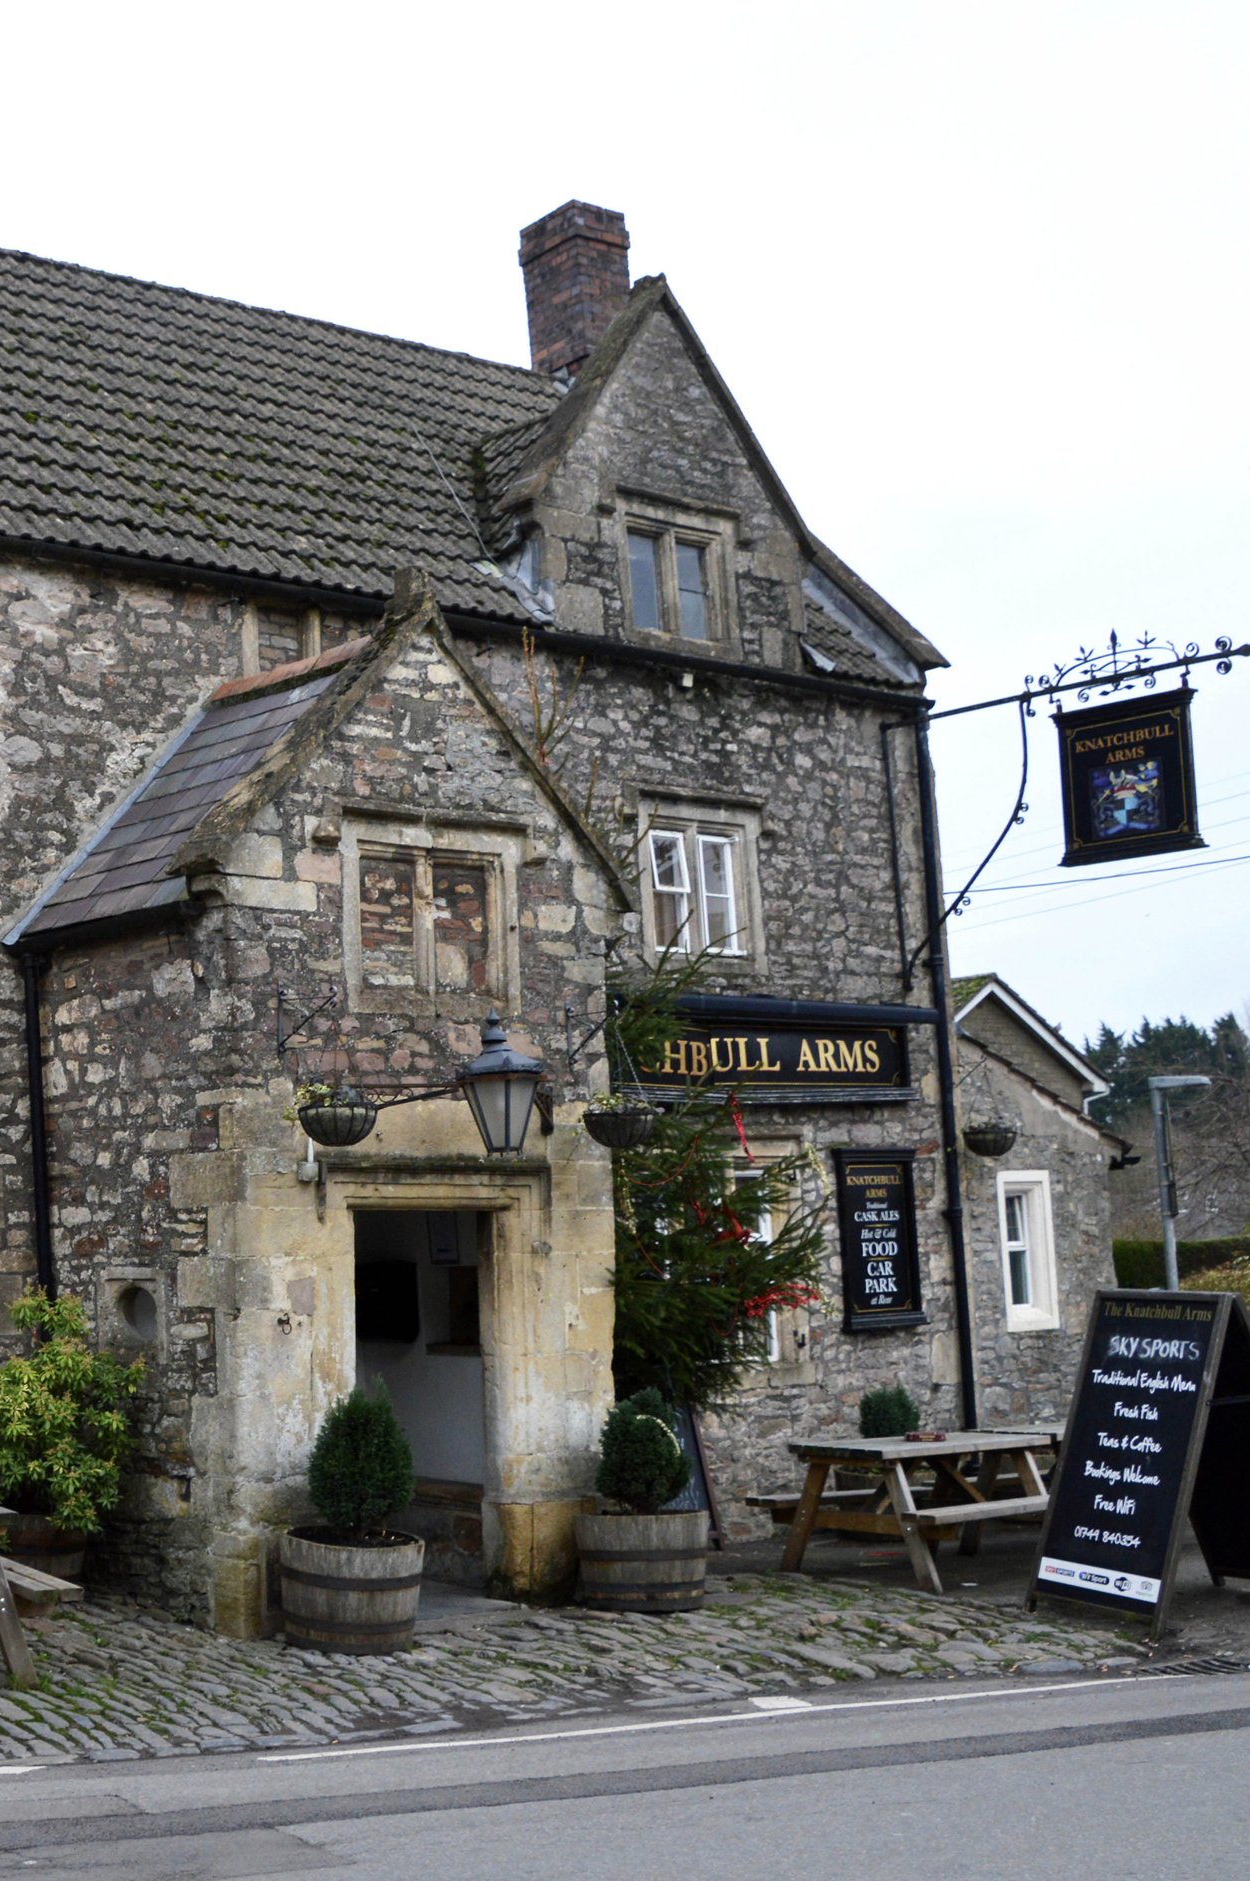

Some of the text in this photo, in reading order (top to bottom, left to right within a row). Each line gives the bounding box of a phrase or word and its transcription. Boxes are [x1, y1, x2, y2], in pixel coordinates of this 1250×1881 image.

[1075, 724, 1174, 753] KNATCHBULL
[1105, 746, 1145, 764] ARMS
[796, 1038, 880, 1073] ARMS
[846, 1175, 902, 1186] KNATCHBULL
[865, 1188, 888, 1198] ARMS
[854, 1211, 900, 1222] CASK ALES
[861, 1229, 897, 1239] Hot & Cold
[861, 1241, 898, 1257] FOOD
[867, 1261, 894, 1276] CAR
[865, 1277, 898, 1294] PARK
[1104, 1302, 1213, 1322] The Knatchbull Arms
[1108, 1335, 1200, 1360] SKY SPORTS
[1092, 1369, 1196, 1394] Traditional English Menu
[1114, 1402, 1158, 1420] Fresh Fish
[1097, 1432, 1162, 1453] Teas & Coffee
[1084, 1460, 1160, 1485] Bookings Welcome
[1094, 1494, 1136, 1515] Free WiFi
[1074, 1525, 1141, 1548] 01749 840354
